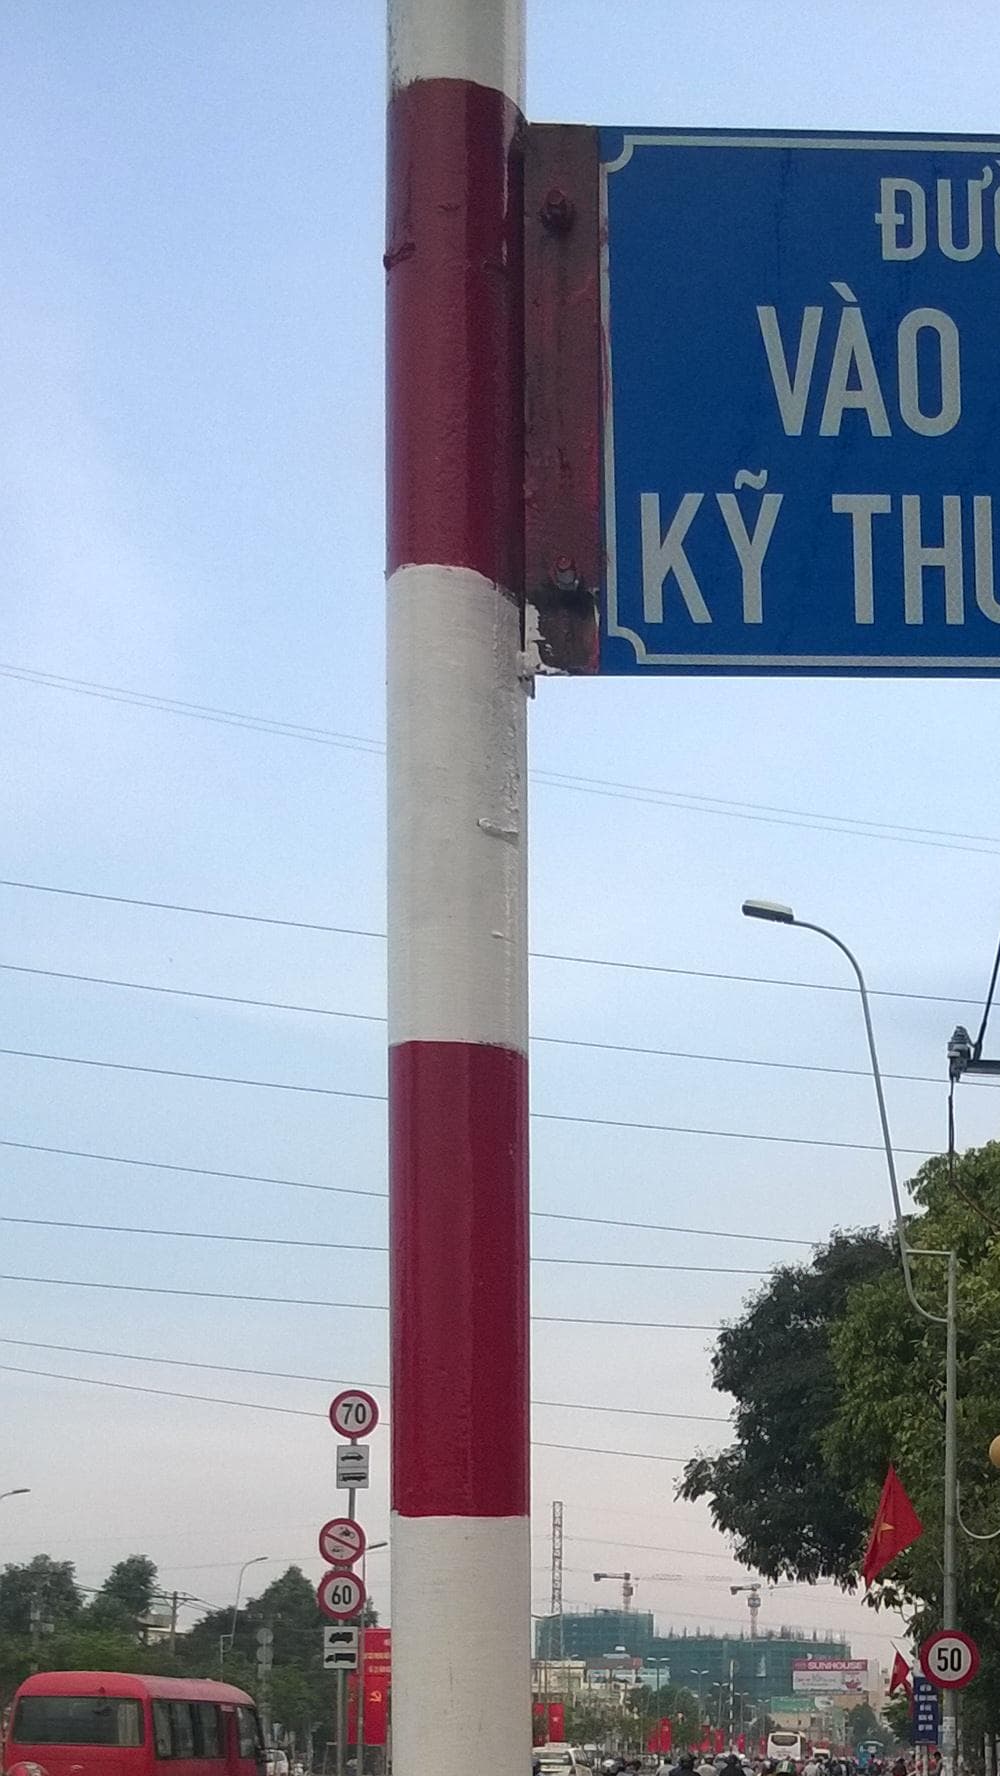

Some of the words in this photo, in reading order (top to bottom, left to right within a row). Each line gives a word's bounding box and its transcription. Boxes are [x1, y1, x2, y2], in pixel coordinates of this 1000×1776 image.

[757, 281, 962, 438] VÀO
[640, 469, 783, 625] KỸ
[341, 1403, 366, 1425] 70
[331, 1585, 352, 1605] 60
[807, 1661, 863, 1670] SUNHOUSE
[937, 1647, 962, 1672] 50
